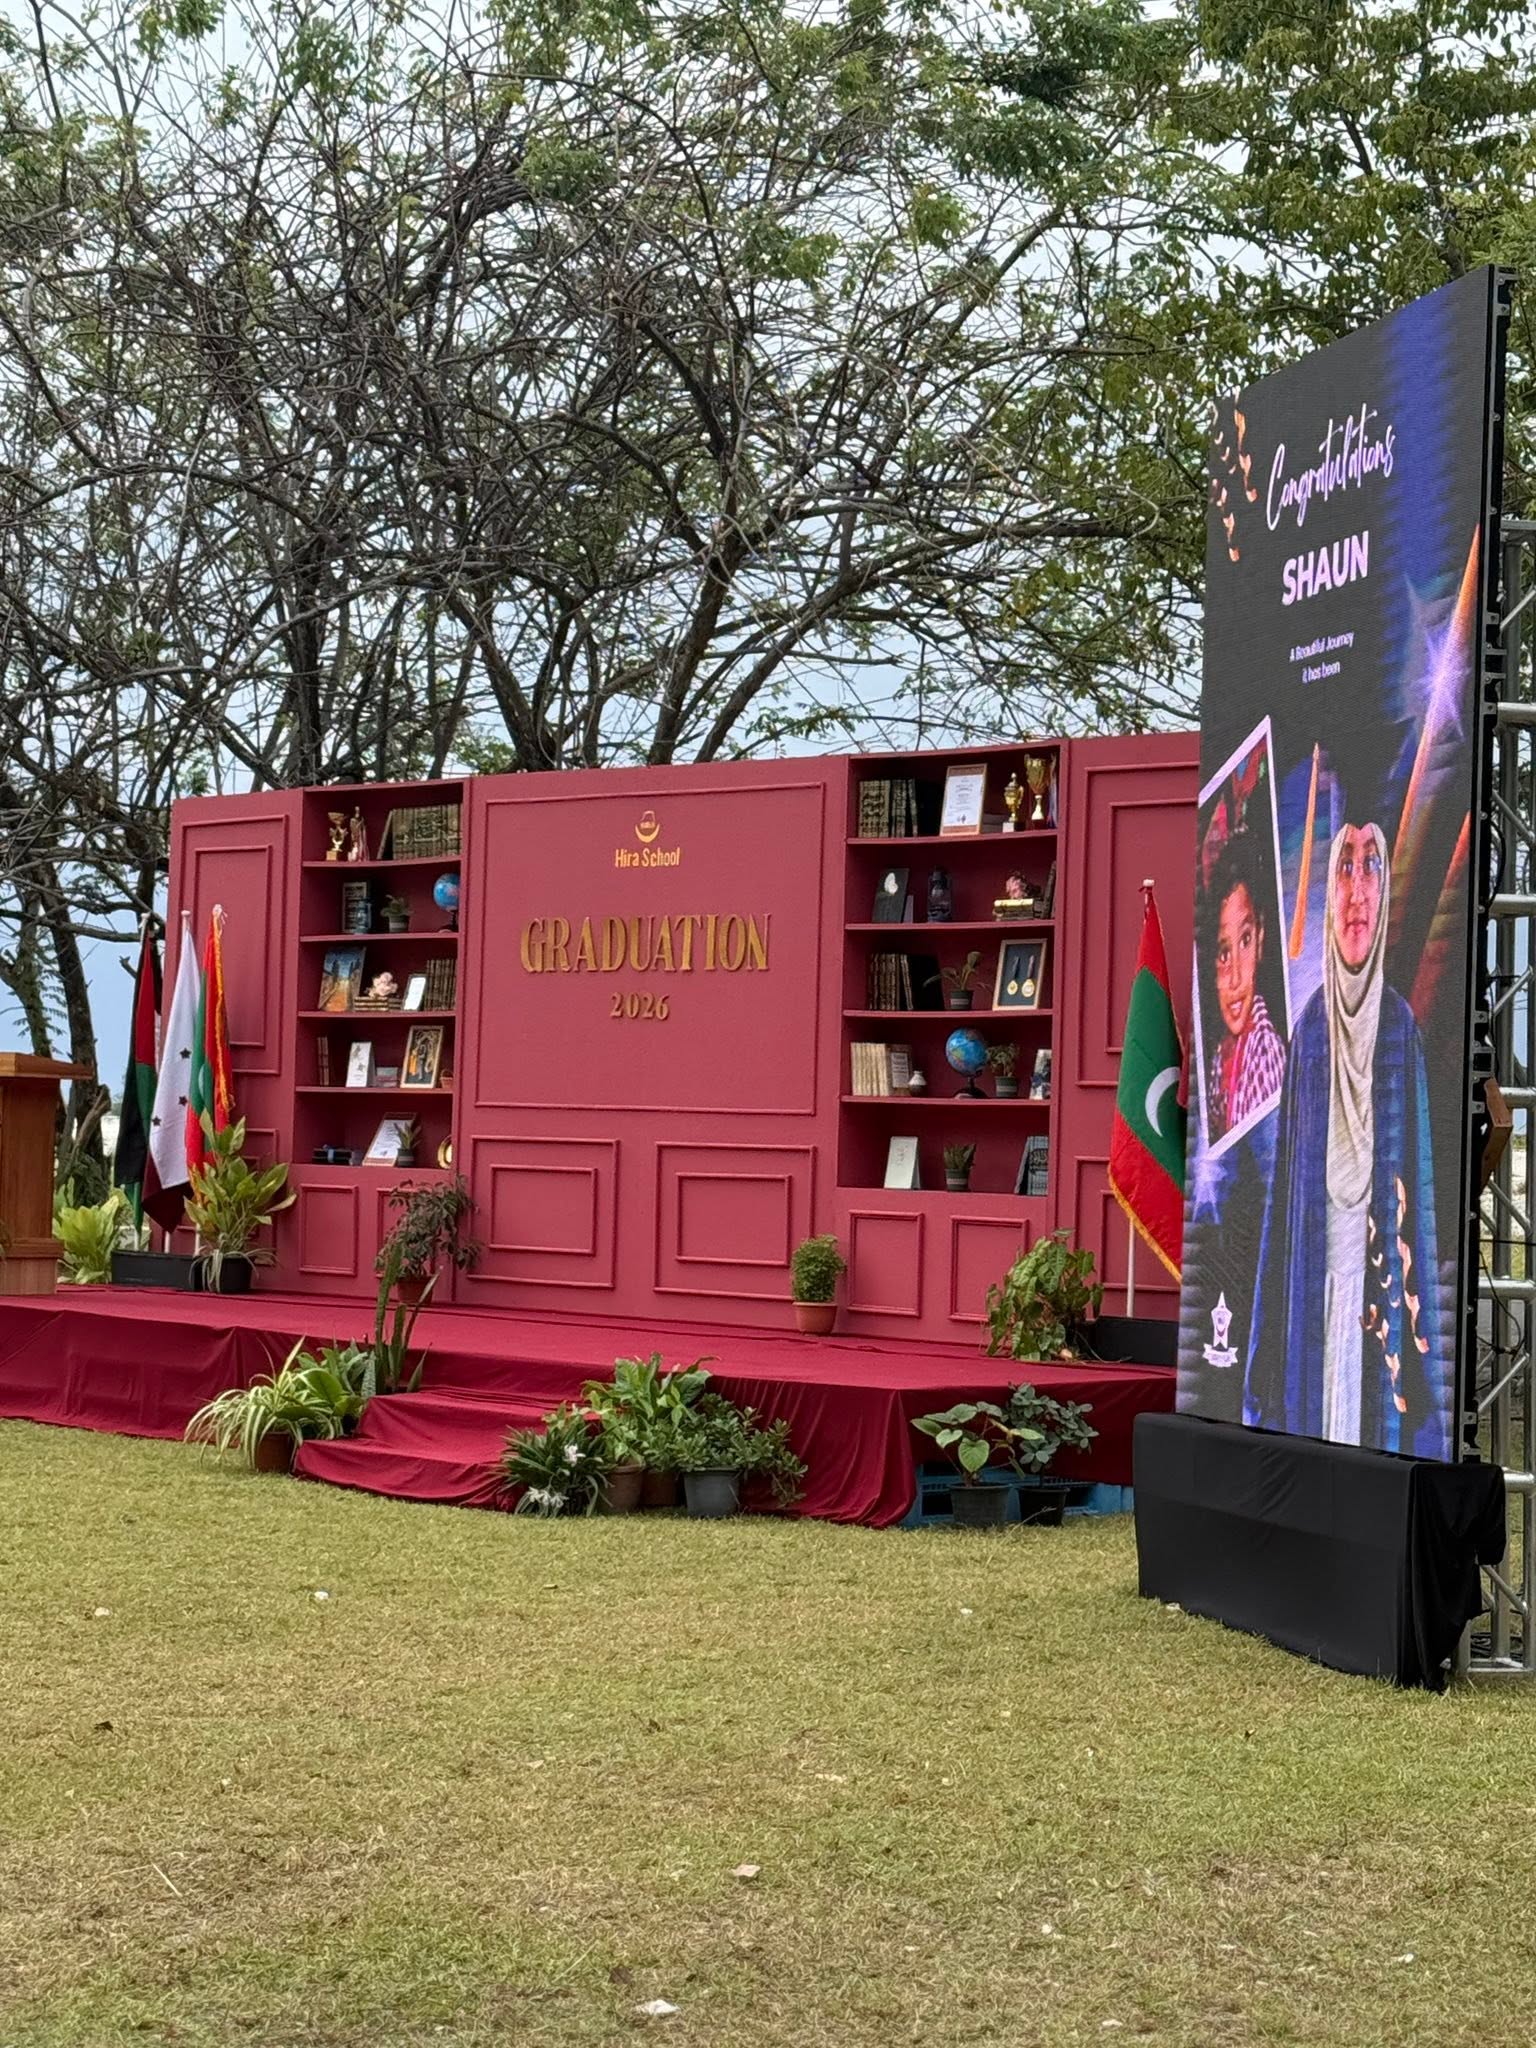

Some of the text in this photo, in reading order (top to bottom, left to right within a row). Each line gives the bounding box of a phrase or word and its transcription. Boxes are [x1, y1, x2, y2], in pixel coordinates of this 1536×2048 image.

[1266, 403, 1396, 531] Congratulations
[1281, 530, 1370, 606] SHAUN
[1308, 665, 1321, 681] has
[1321, 661, 1341, 678] been
[614, 846, 681, 868] Hira School
[520, 913, 773, 973] GRADUATION
[610, 992, 670, 1021] 2026
